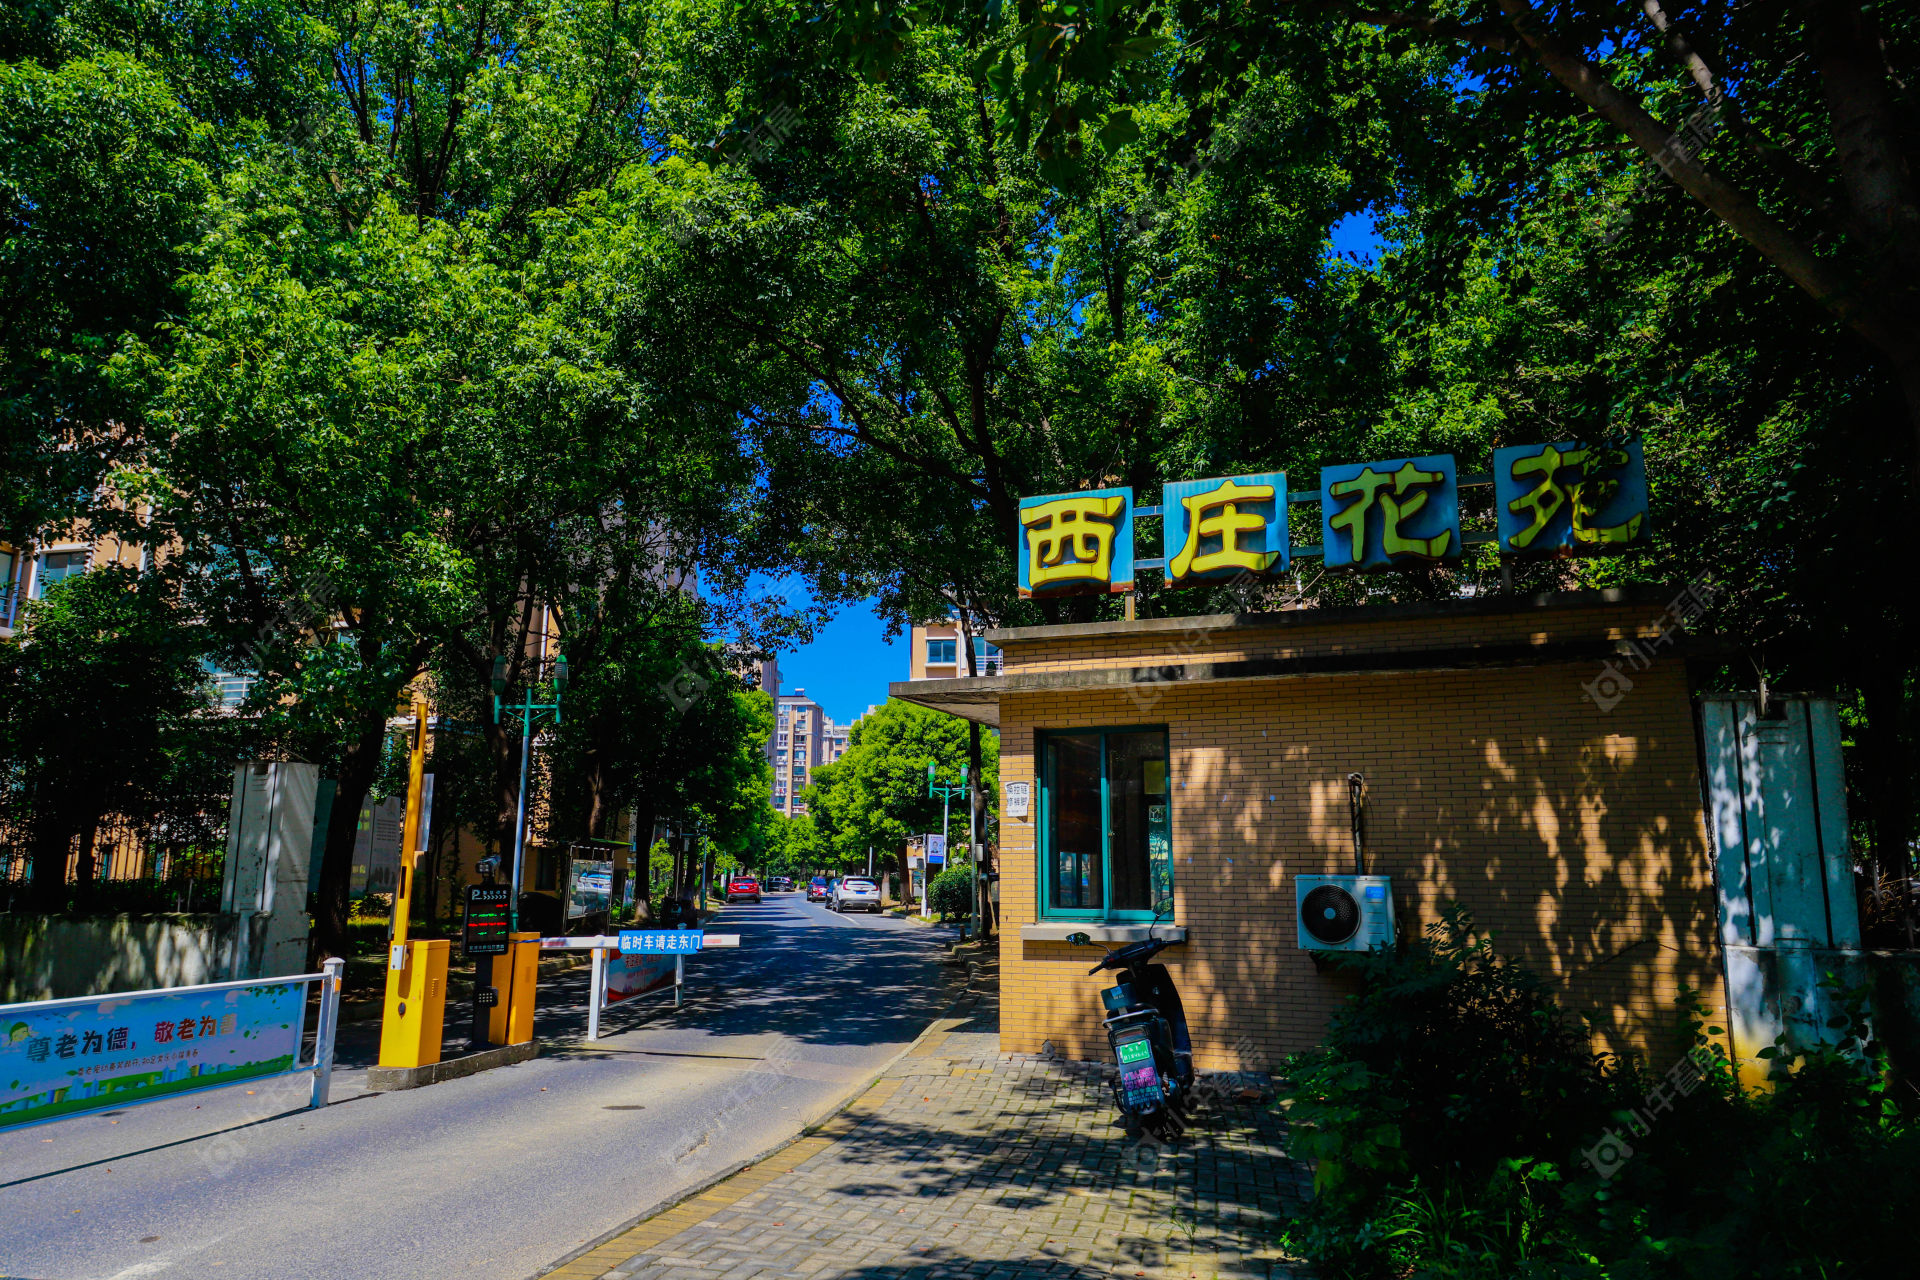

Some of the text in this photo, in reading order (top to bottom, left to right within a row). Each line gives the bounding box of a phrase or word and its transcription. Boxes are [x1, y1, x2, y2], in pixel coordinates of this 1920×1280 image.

[1020, 445, 1643, 590] 西庄花苑
[620, 933, 701, 950] 临时车请走东门
